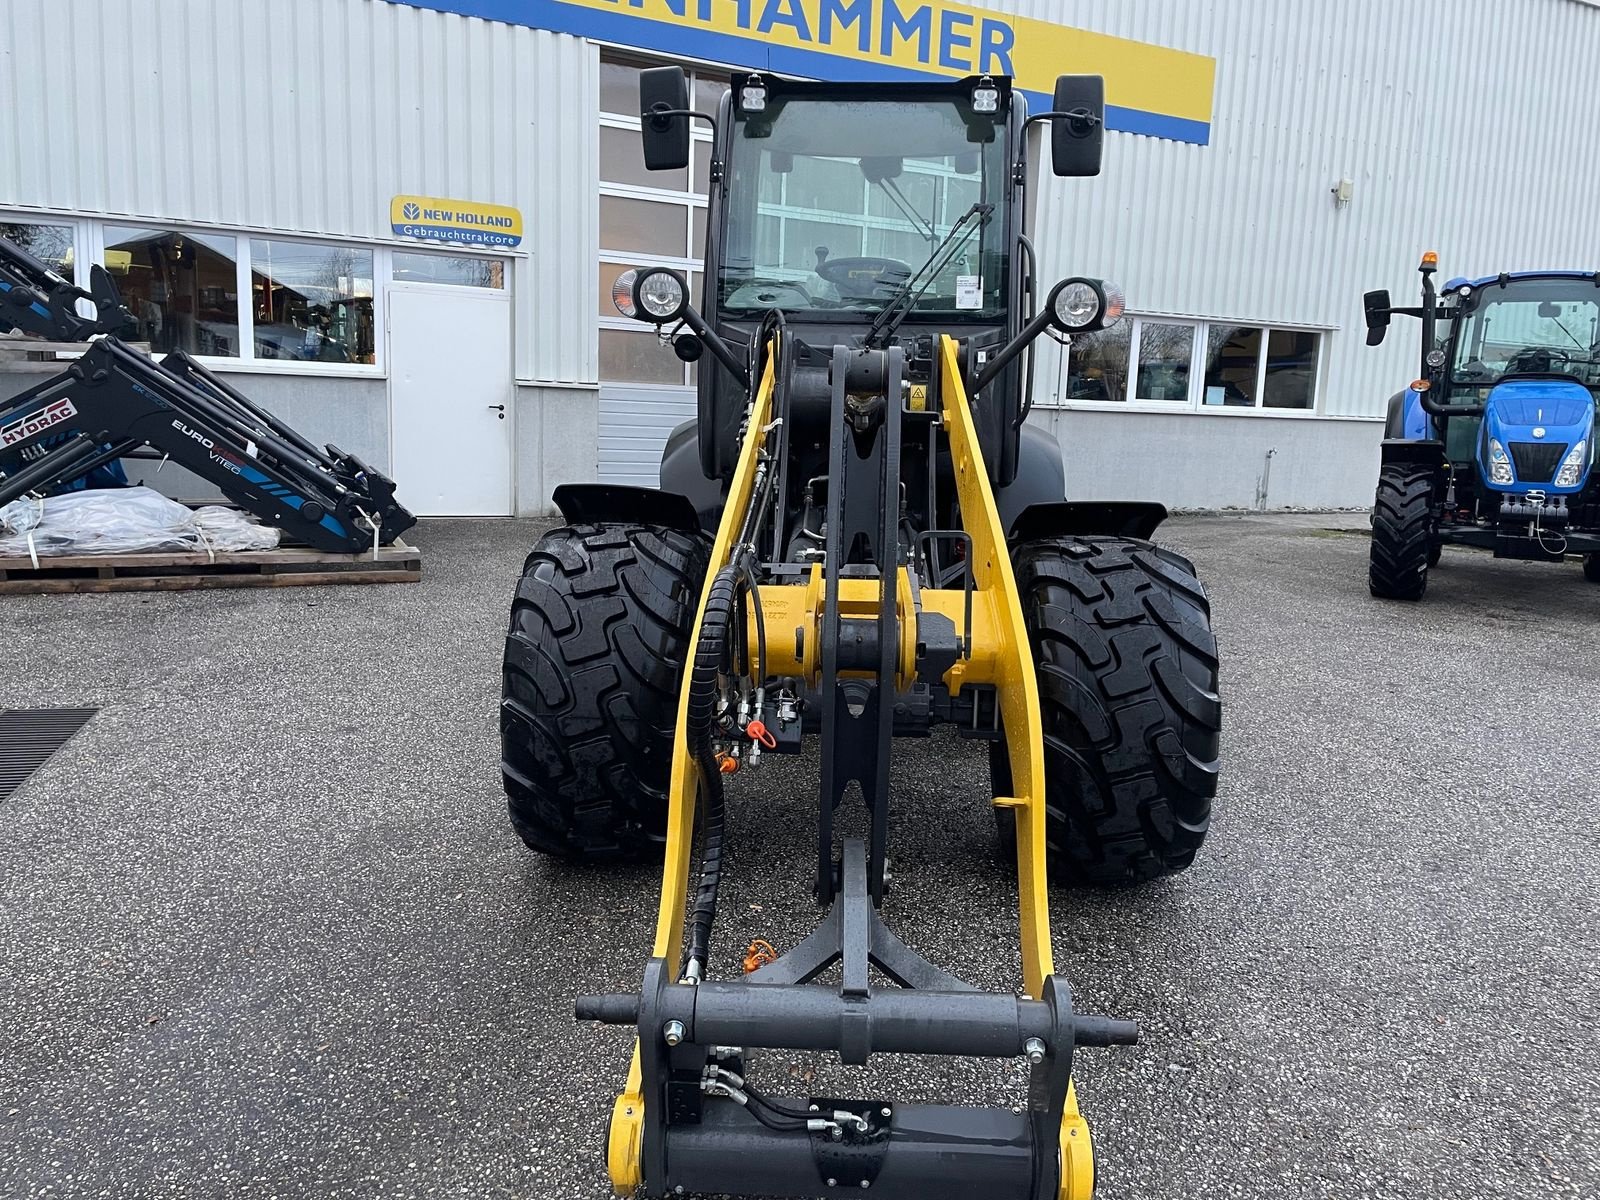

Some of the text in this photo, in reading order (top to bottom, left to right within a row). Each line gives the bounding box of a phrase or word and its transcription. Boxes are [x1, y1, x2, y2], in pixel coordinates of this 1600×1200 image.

[603, 0, 1016, 79] AMMER
[423, 208, 513, 228] NEW HOLLAND
[403, 225, 515, 245] Gebrauchttraktore
[2, 407, 72, 444] HYDRAC
